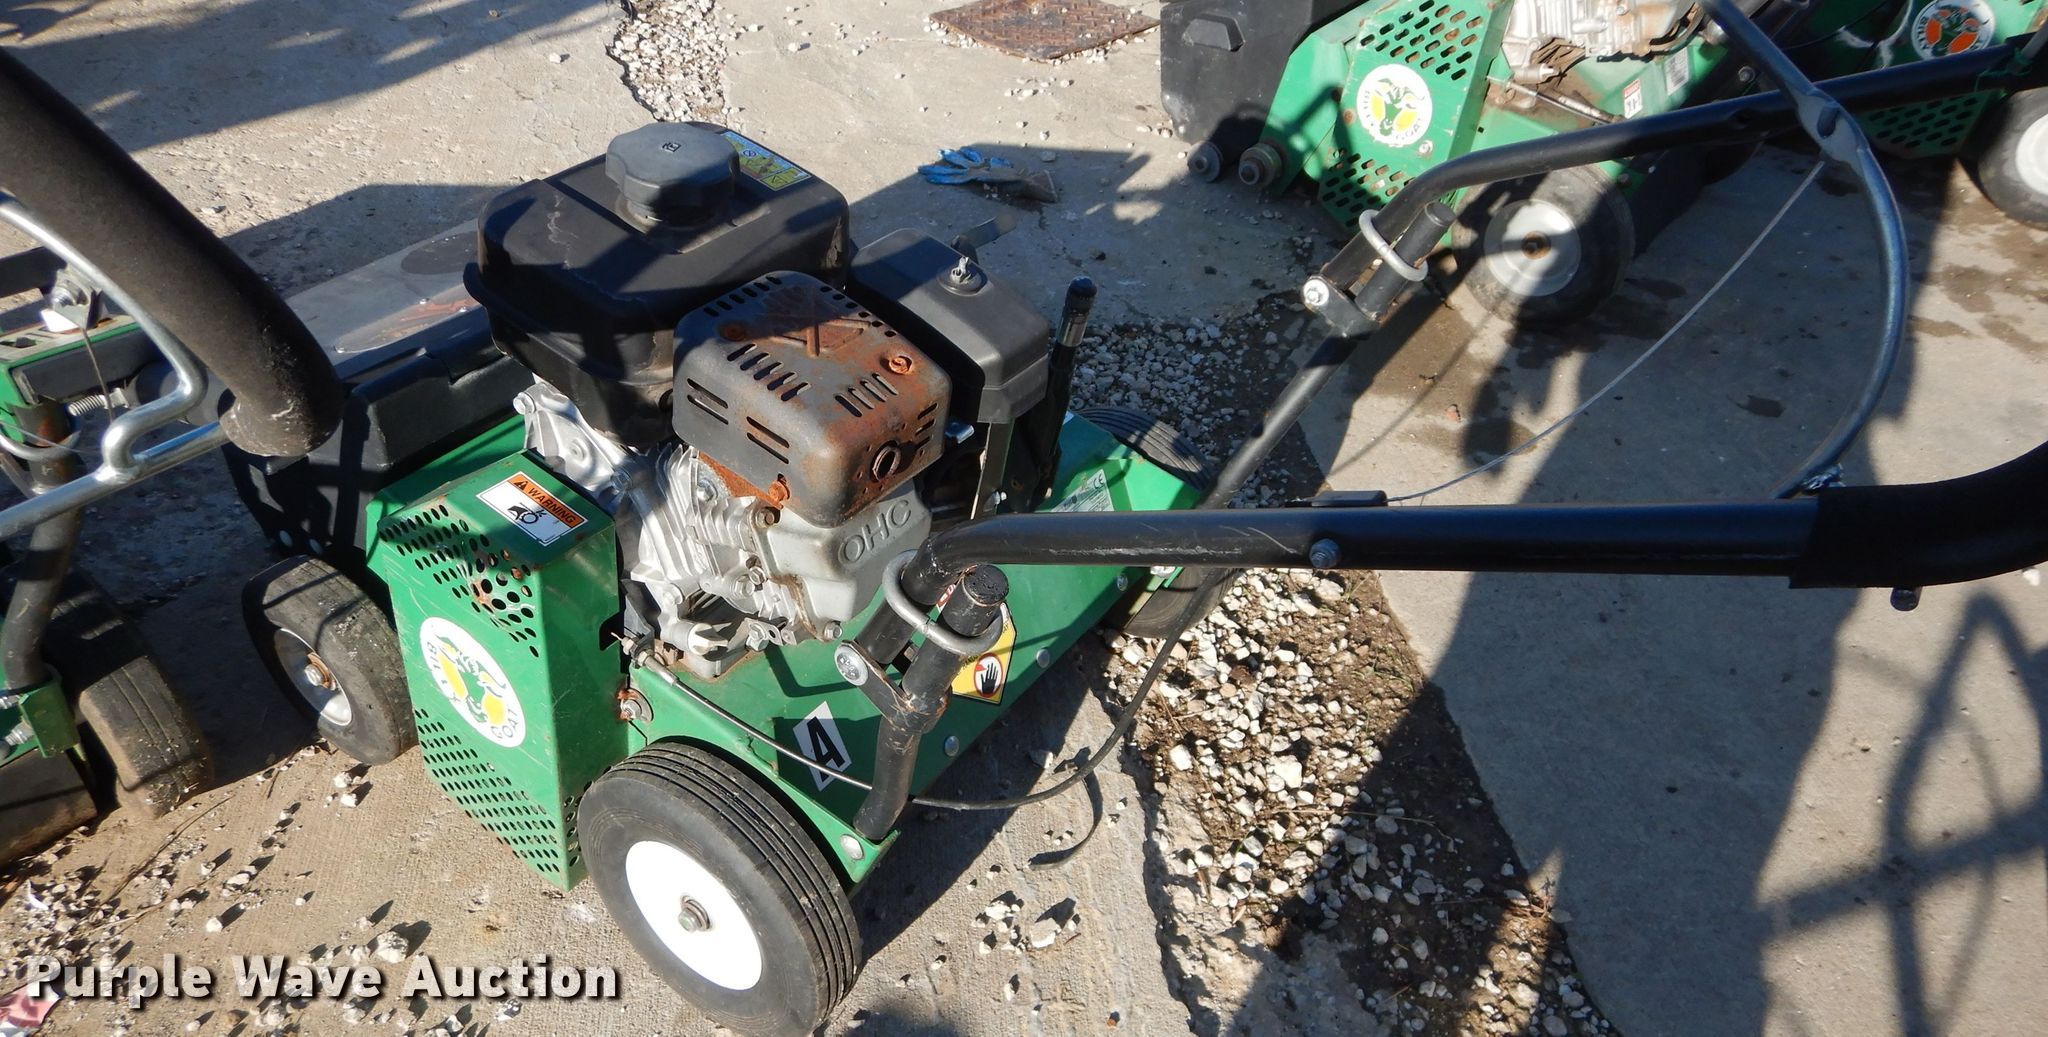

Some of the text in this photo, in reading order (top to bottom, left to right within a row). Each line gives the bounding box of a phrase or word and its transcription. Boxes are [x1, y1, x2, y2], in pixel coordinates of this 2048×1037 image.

[529, 487, 576, 523] WARNING
[838, 500, 912, 565] OHC
[807, 716, 846, 783] A
